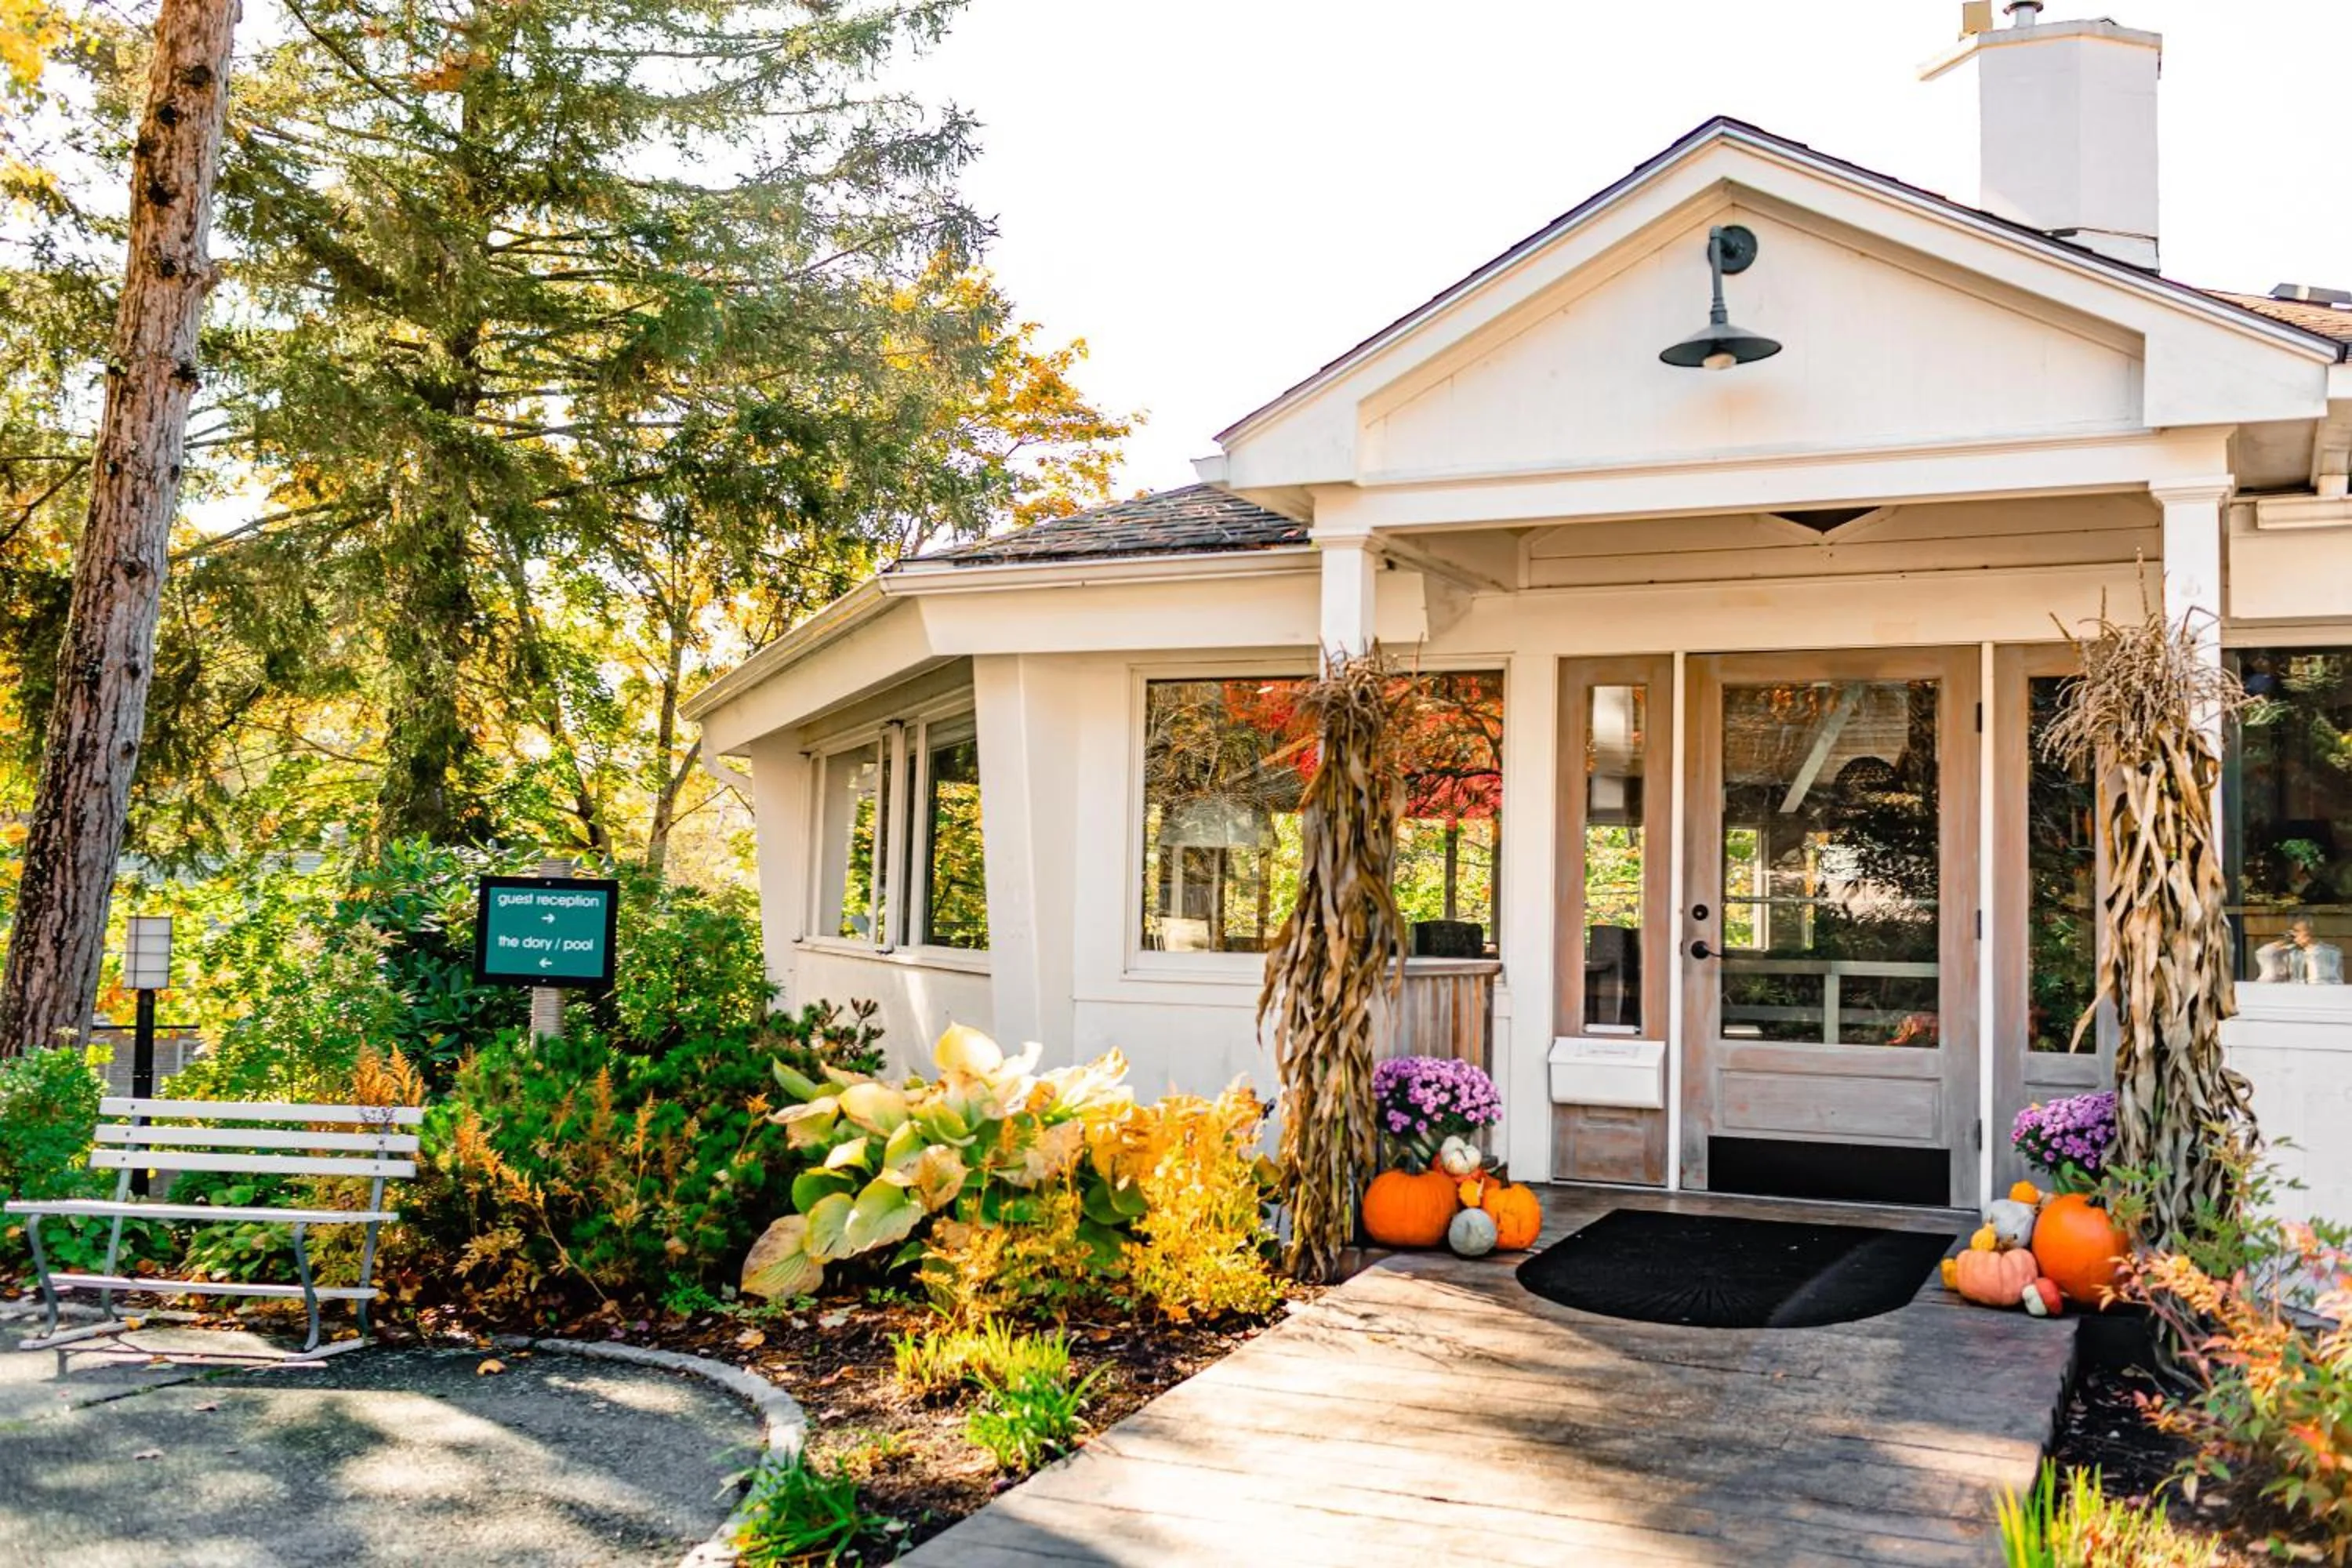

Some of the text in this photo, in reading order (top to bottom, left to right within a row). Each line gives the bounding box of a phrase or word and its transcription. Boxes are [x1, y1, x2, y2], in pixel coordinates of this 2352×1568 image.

[498, 894, 599, 907] guest reception
[498, 935, 593, 952] the dory / pool
